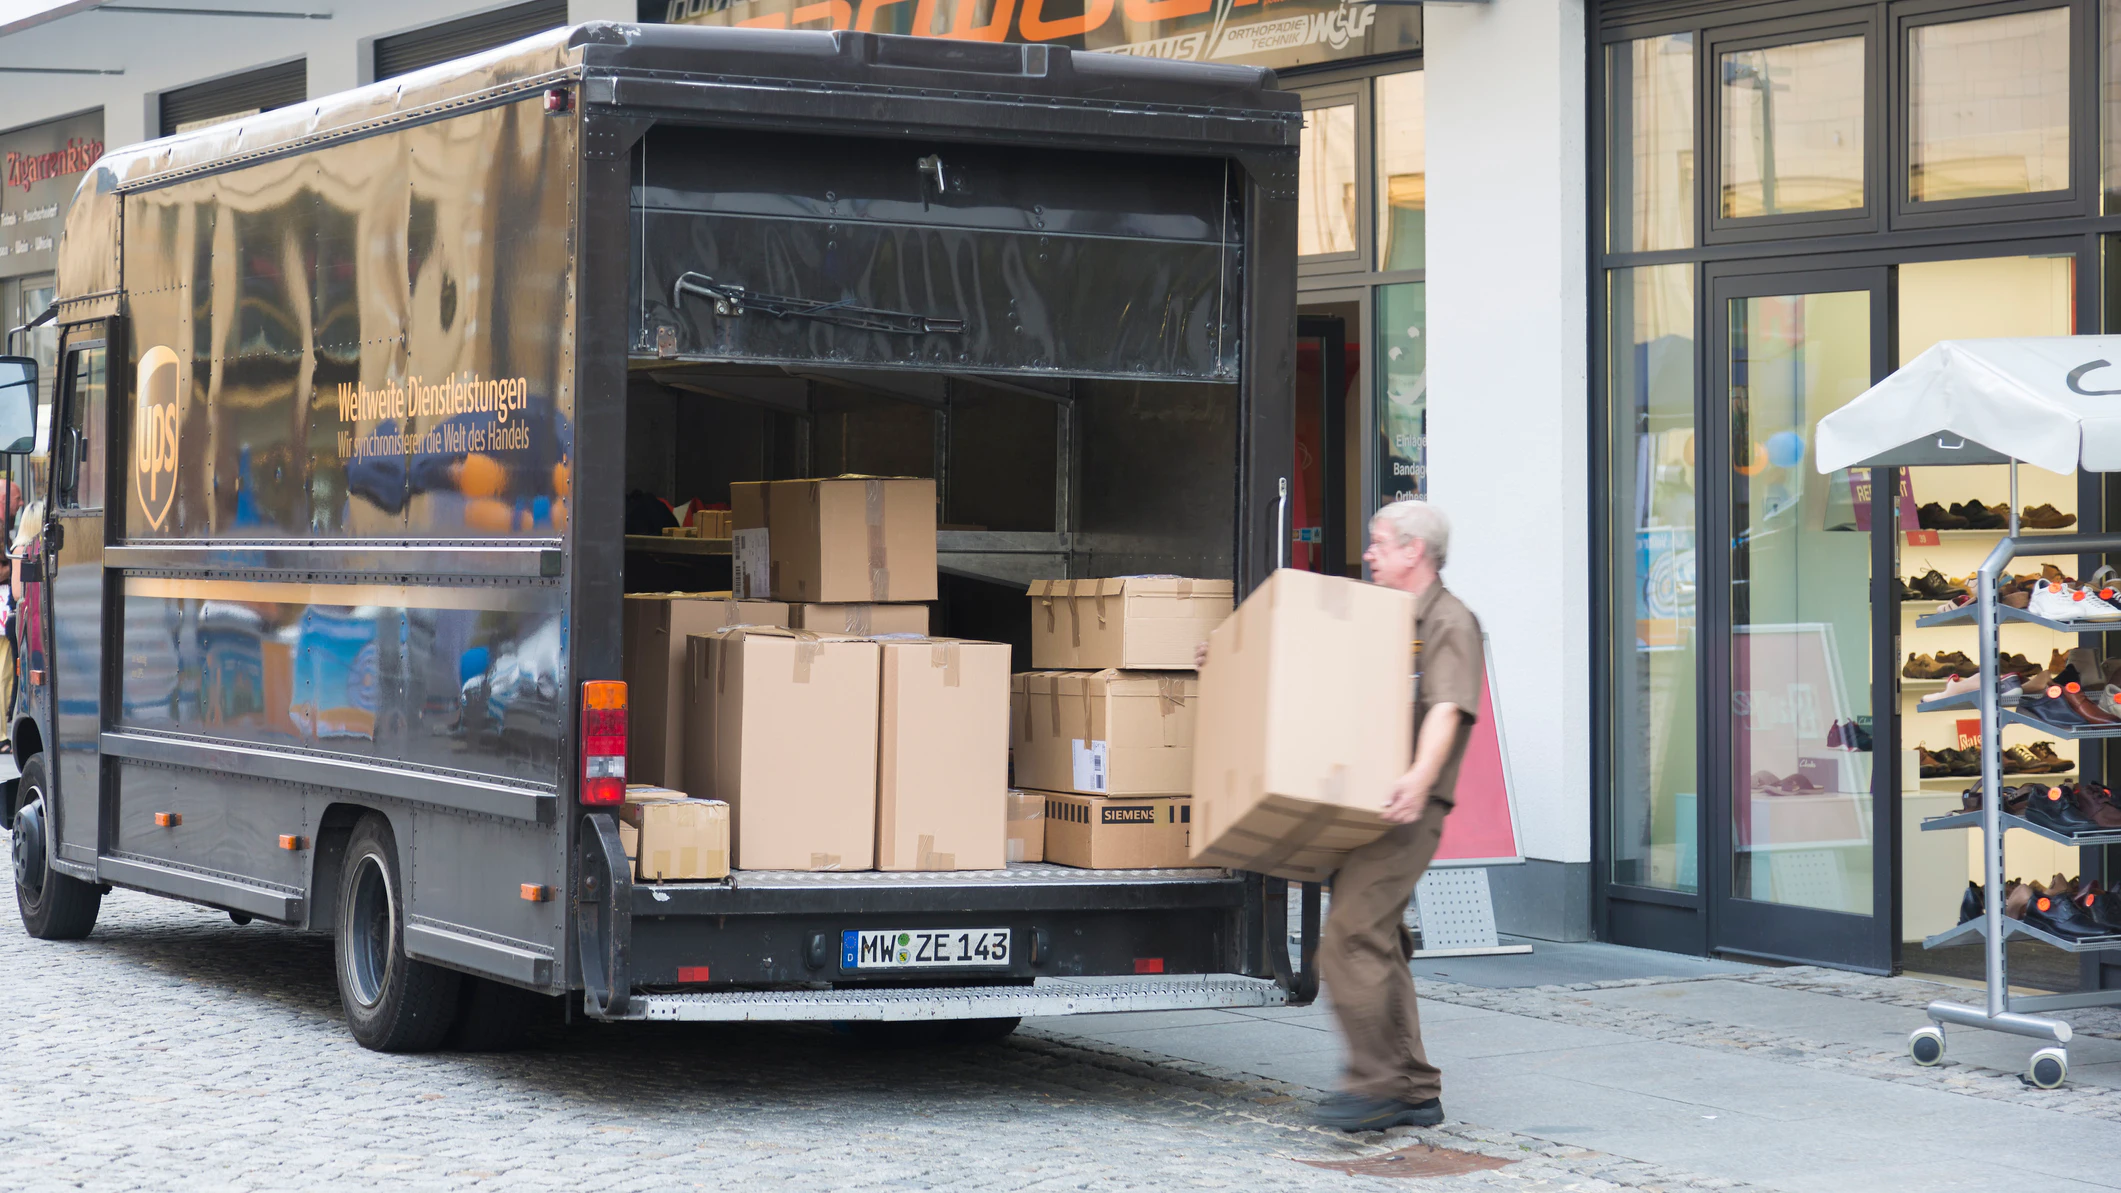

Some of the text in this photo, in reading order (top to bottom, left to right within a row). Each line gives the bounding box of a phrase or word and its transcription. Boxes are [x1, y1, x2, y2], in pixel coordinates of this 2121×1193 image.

[1227, 19, 1306, 41] ORTHOPÄDIE-
[1251, 32, 1301, 50] TECHNIK
[7, 137, 104, 193] Zigarrenkiste
[338, 371, 527, 423] Weltweite Dienstleistungen
[337, 419, 529, 465] Wir synchronisieren die Welt des Handels
[1104, 809, 1155, 821] SIEMENS
[847, 953, 854, 962] D
[860, 932, 1008, 963] MW ZE 143
